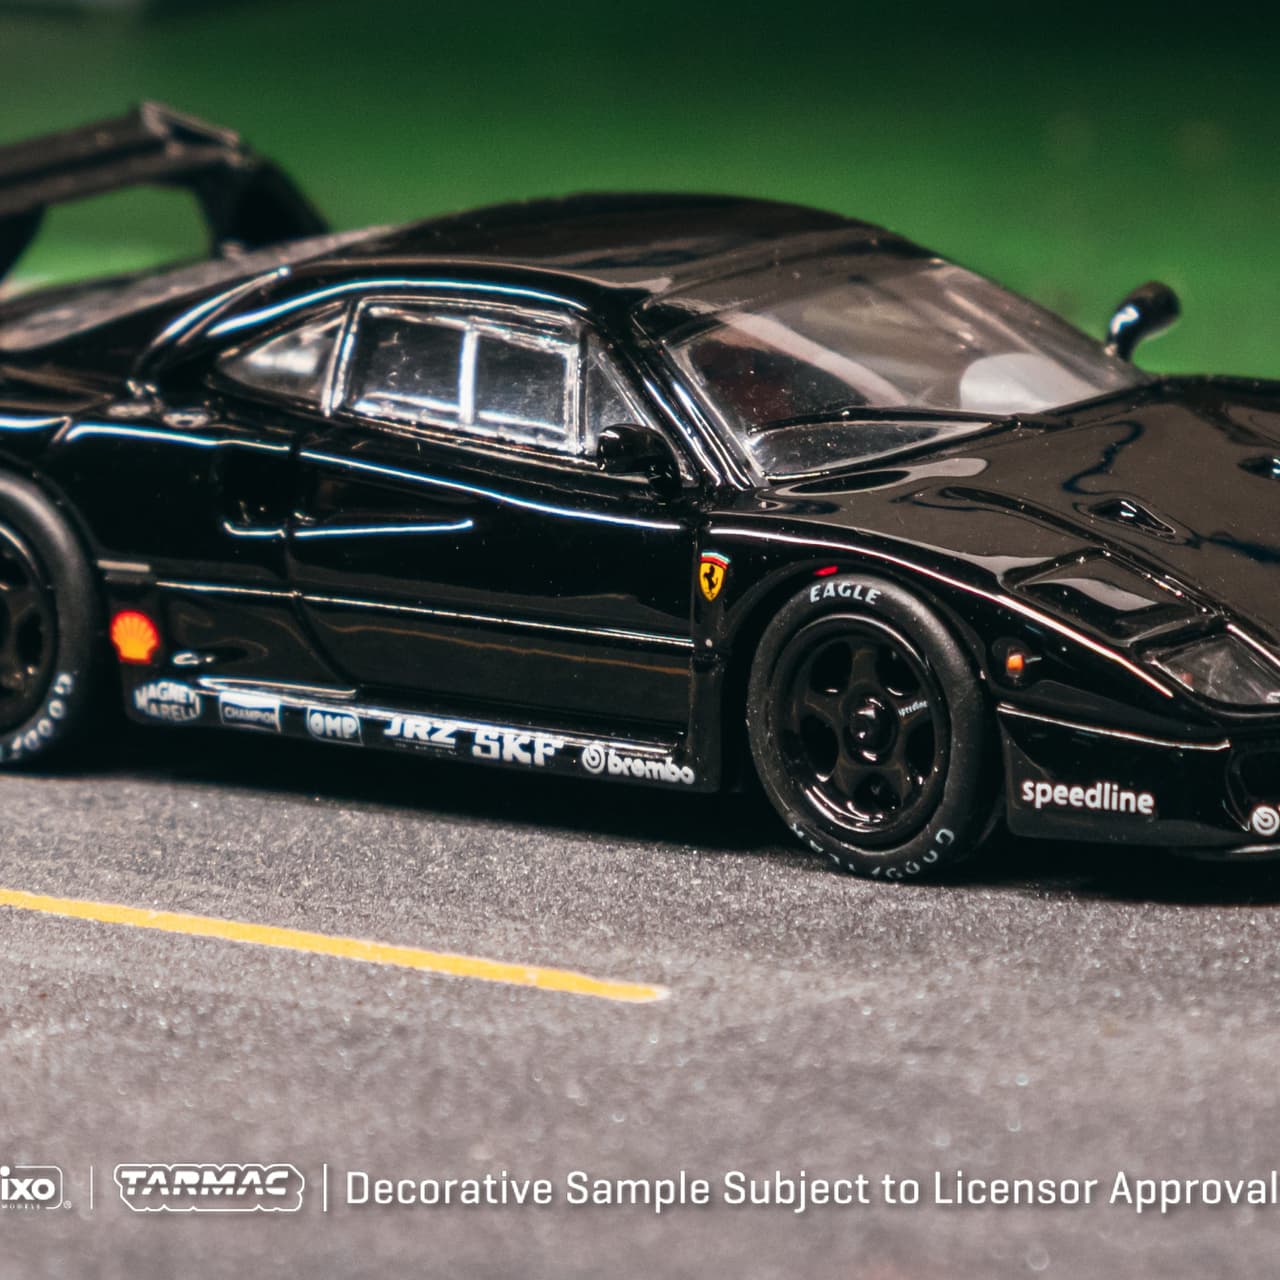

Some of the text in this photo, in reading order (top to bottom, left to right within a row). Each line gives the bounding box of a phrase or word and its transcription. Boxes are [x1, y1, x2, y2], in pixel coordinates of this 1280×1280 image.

[809, 581, 882, 605] EAGLE
[309, 712, 357, 738] OMP
[383, 716, 456, 745] JRZ
[472, 728, 564, 766] SKF
[607, 749, 695, 785] brembo
[1022, 780, 1154, 814] speedline
